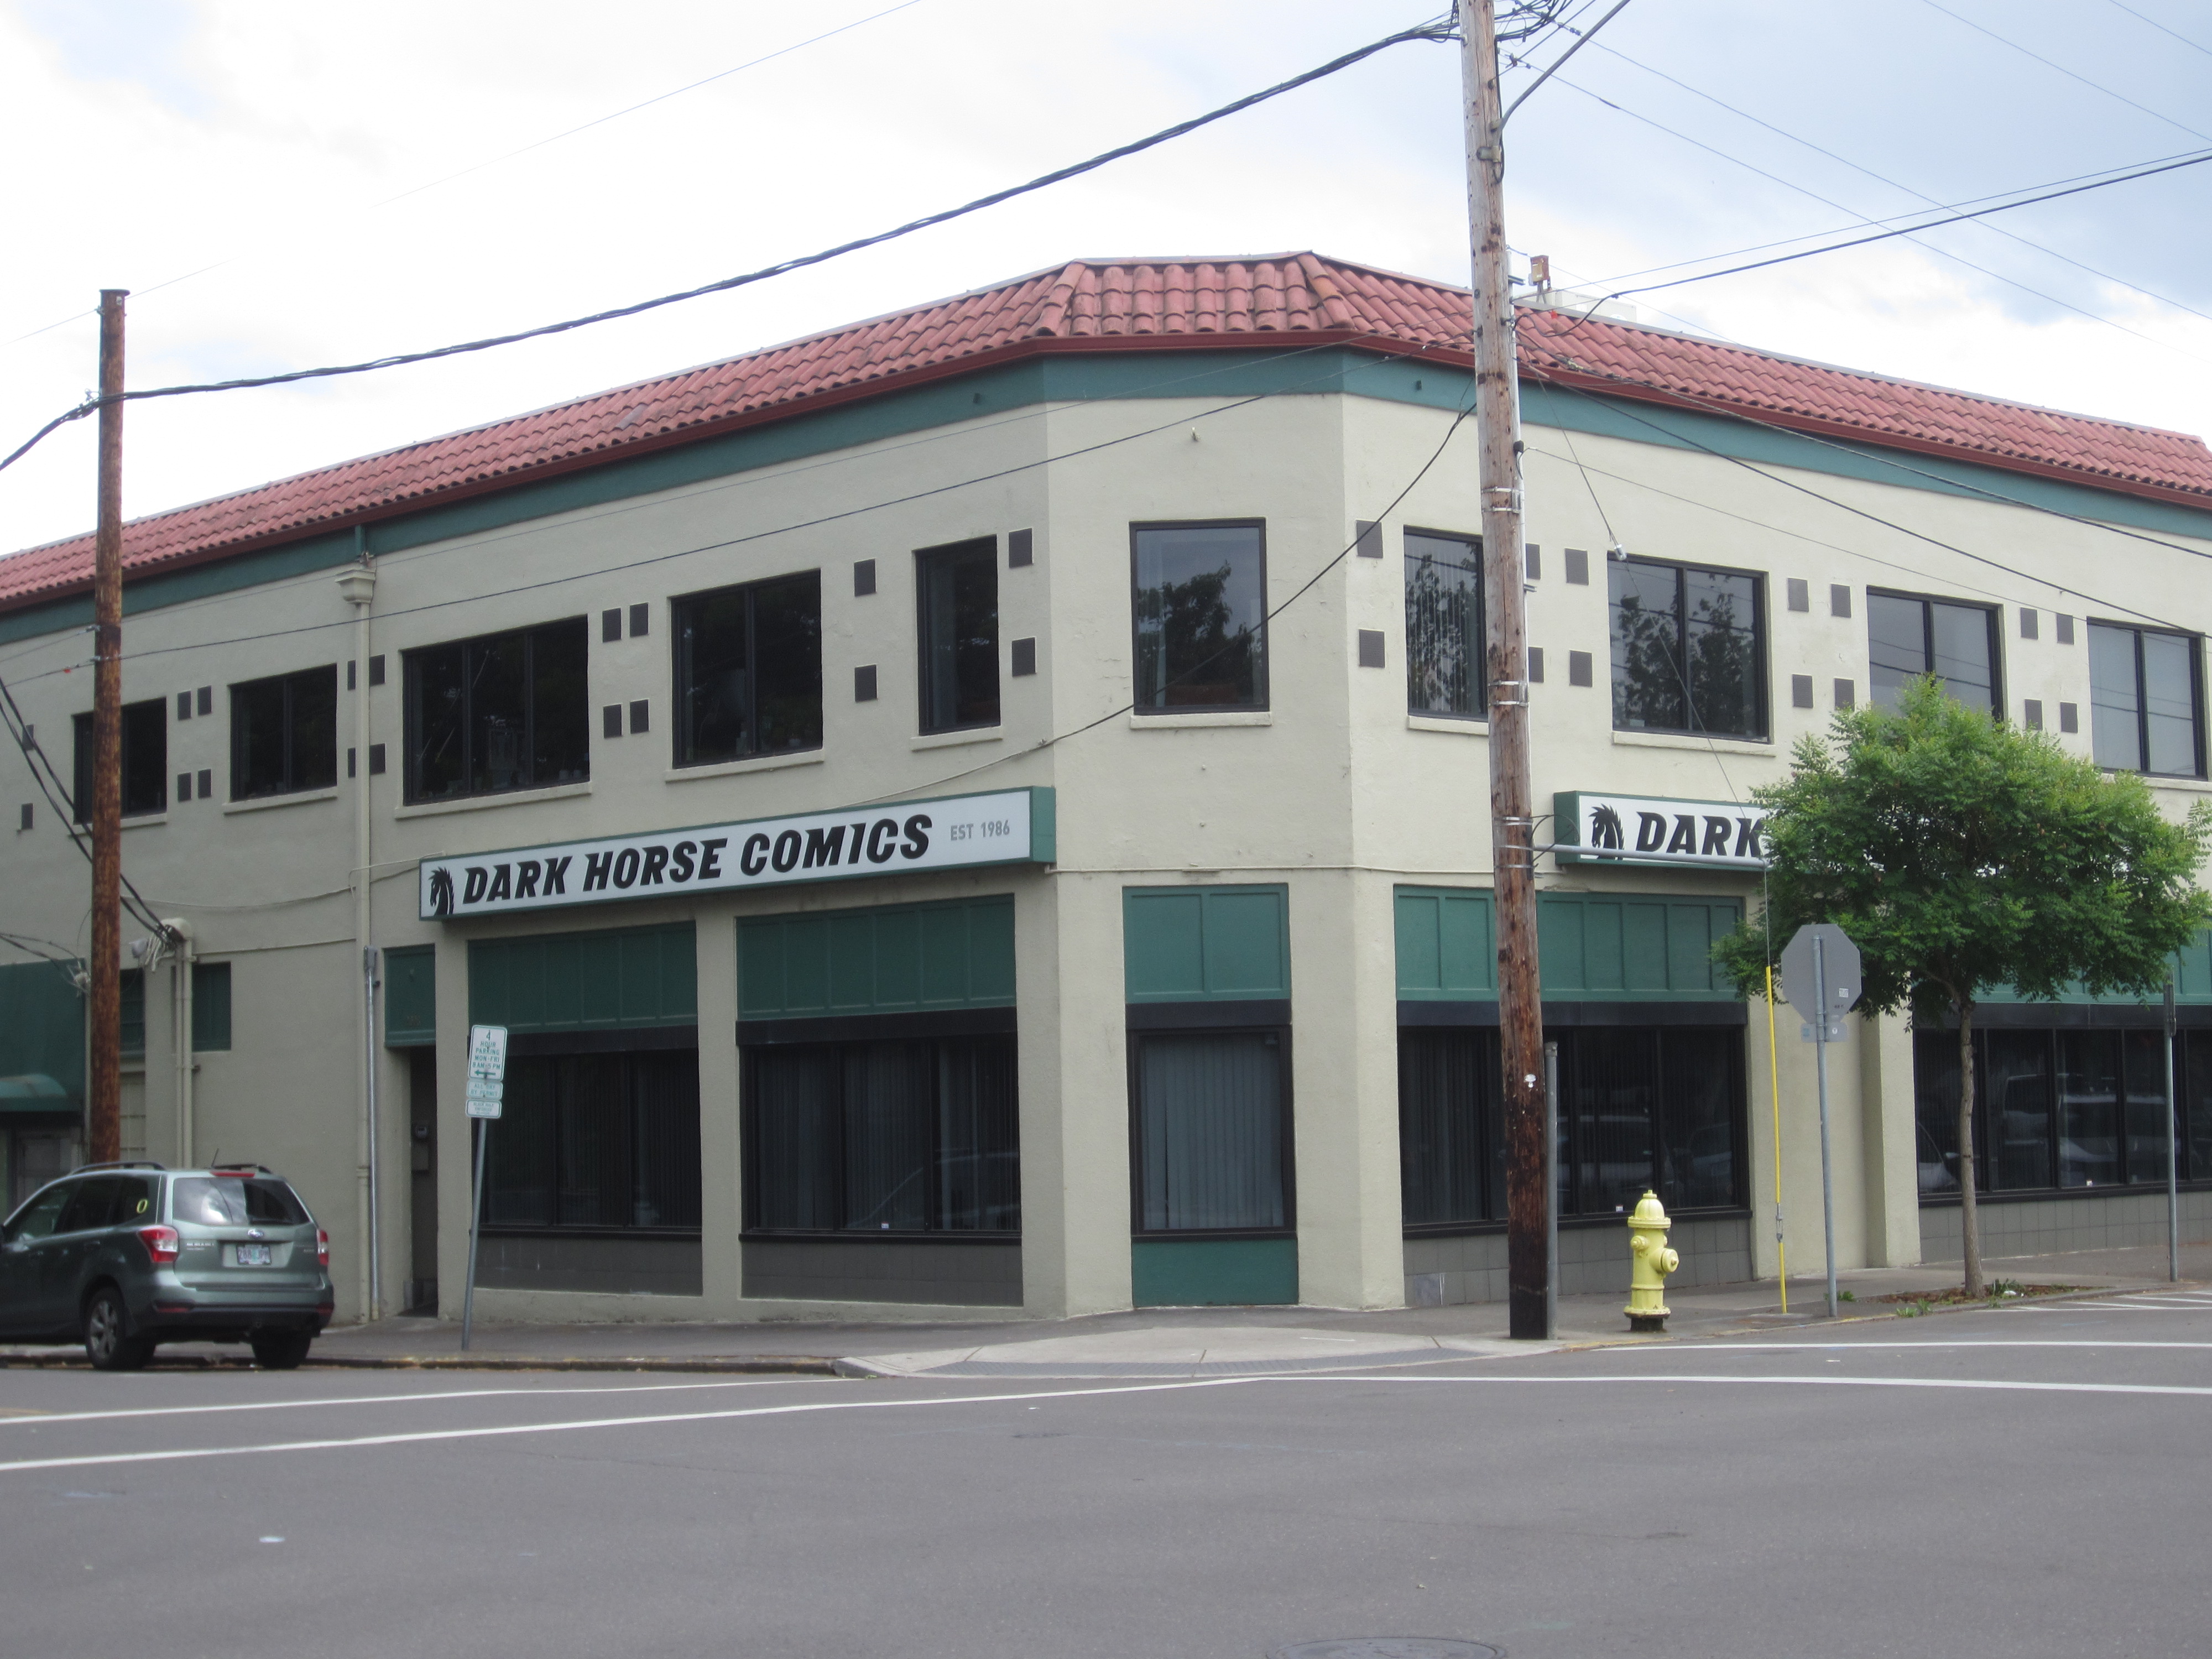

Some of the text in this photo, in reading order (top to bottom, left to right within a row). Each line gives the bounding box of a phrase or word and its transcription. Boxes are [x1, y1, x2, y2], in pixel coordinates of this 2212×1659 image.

[1635, 811, 1764, 858] DARK
[462, 814, 1011, 904] DARK HORSE COMICS EST 1986
[486, 1030, 491, 1041] 4
